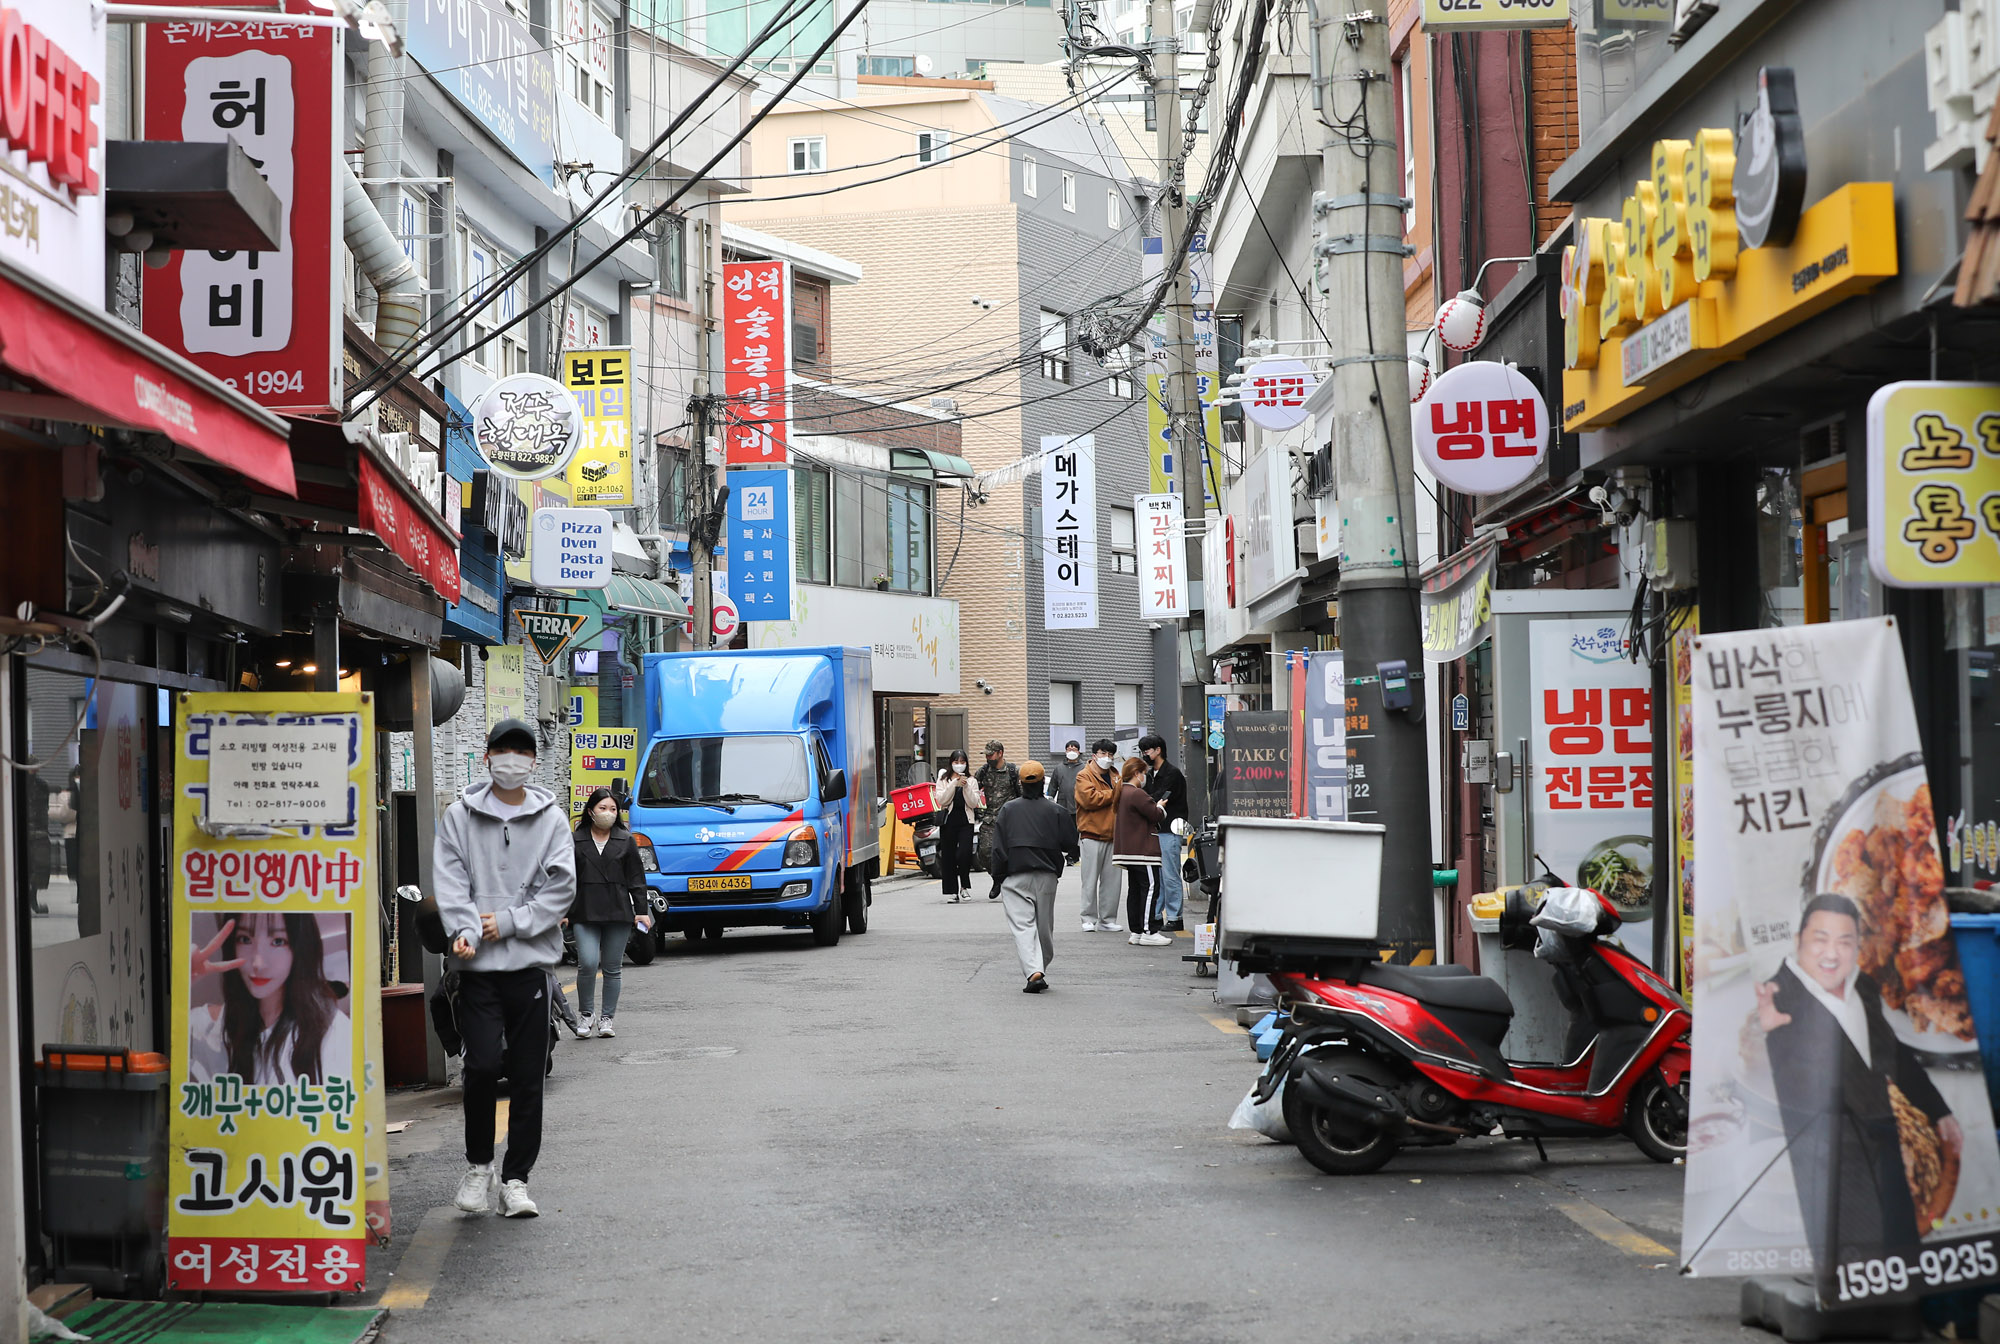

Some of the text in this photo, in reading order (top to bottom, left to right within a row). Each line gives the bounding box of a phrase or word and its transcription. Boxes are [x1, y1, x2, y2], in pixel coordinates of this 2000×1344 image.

[0, 8, 100, 195] OFFEE
[727, 268, 779, 301] 언덕
[244, 370, 304, 394] 1994
[571, 357, 625, 386] 보드
[731, 306, 780, 456] 숯불갈비
[1253, 378, 1304, 407] 치킨
[500, 391, 554, 420] 전주
[480, 416, 572, 456] 현대옥
[1430, 398, 1538, 460] 냉면
[490, 450, 555, 465] 노량진점 822-9882
[619, 450, 629, 458] B1
[576, 485, 624, 494] 02-812-1062
[747, 492, 768, 507] 24
[1148, 501, 1172, 511] 백채
[561, 522, 602, 534] Pizza
[1055, 452, 1079, 587] 메가스테이
[561, 537, 597, 549] Oven
[743, 528, 773, 540] 복사
[561, 553, 604, 565] Pasta
[1150, 514, 1176, 609] 김치찌개
[560, 568, 596, 579] Beer
[744, 570, 774, 582] 스캔
[521, 614, 573, 639] TERRA
[1707, 639, 1821, 690] 바삭한
[1456, 712, 1464, 726] 22
[1544, 688, 1652, 755] 냉면
[1716, 681, 1869, 739] 누룽지에
[272, 742, 306, 752] 여성전용
[311, 742, 337, 752] 고시원
[600, 734, 634, 750] 고시원
[271, 761, 303, 771] 있습니다
[583, 757, 595, 766] 1F
[1231, 748, 1276, 761] TAKE
[1724, 735, 1840, 790] 달콤한
[233, 780, 320, 790] 아래 전화로 연락주세요
[1354, 783, 1370, 797] 22
[1545, 766, 1652, 809] 전문점
[227, 800, 243, 808] Tel
[255, 800, 327, 808] 02-817-9006
[901, 798, 926, 812] 요기요
[1734, 787, 1812, 835] 치킨
[185, 851, 360, 898] 할인행사中
[720, 877, 748, 889] 6436
[182, 1075, 356, 1133] 깨끗+아늑한
[179, 1146, 353, 1225] 고시원
[173, 1244, 360, 1284] 여성전용
[1836, 1240, 1998, 1301] 1599-9235
